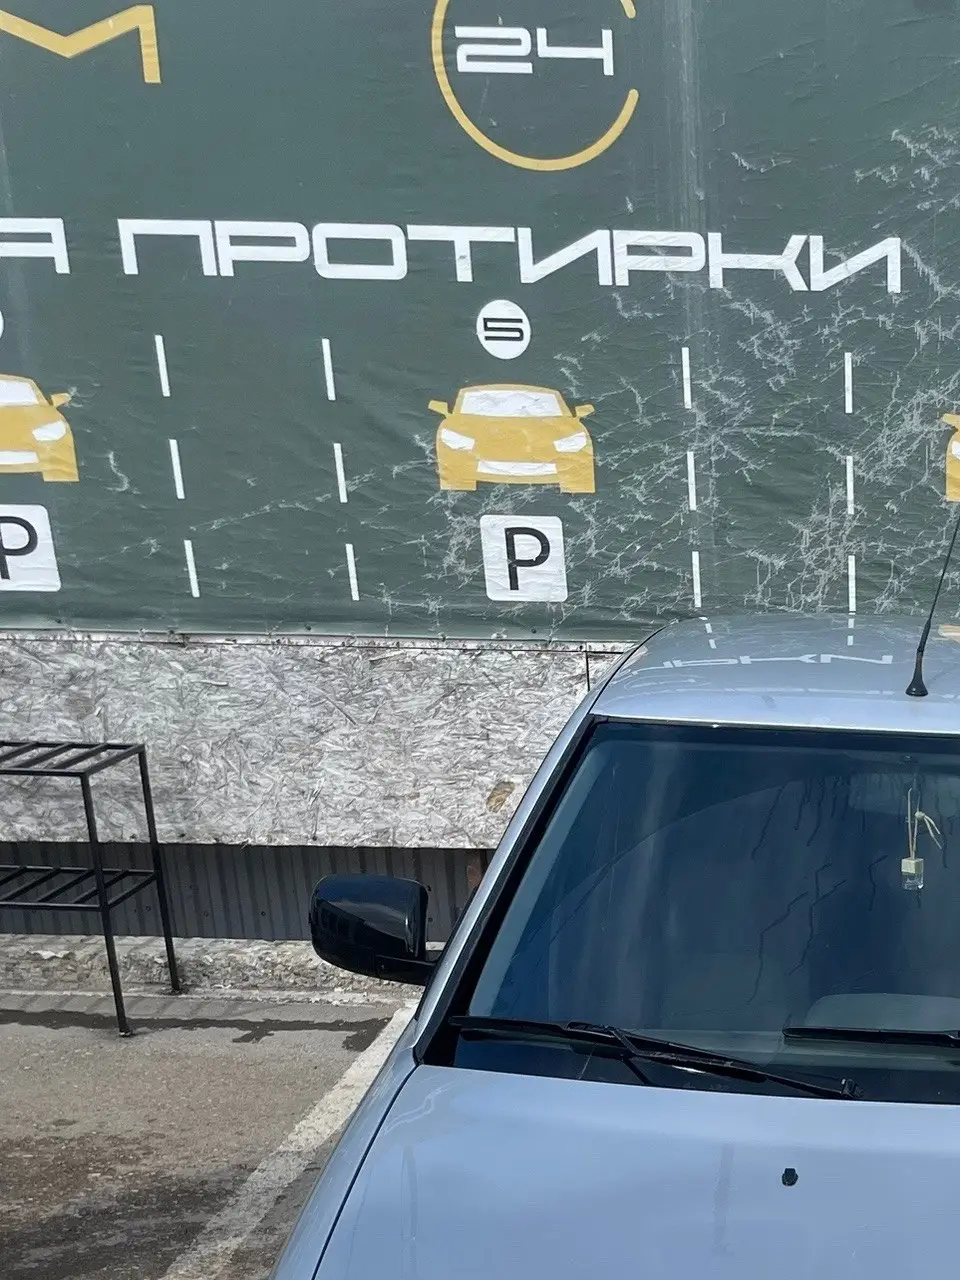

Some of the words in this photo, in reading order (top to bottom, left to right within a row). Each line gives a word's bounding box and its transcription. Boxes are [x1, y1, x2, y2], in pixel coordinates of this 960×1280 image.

[454, 26, 615, 76] 24
[117, 218, 902, 294] ПРОТИРКИ
[483, 317, 524, 342] 5
[504, 526, 551, 591] P
